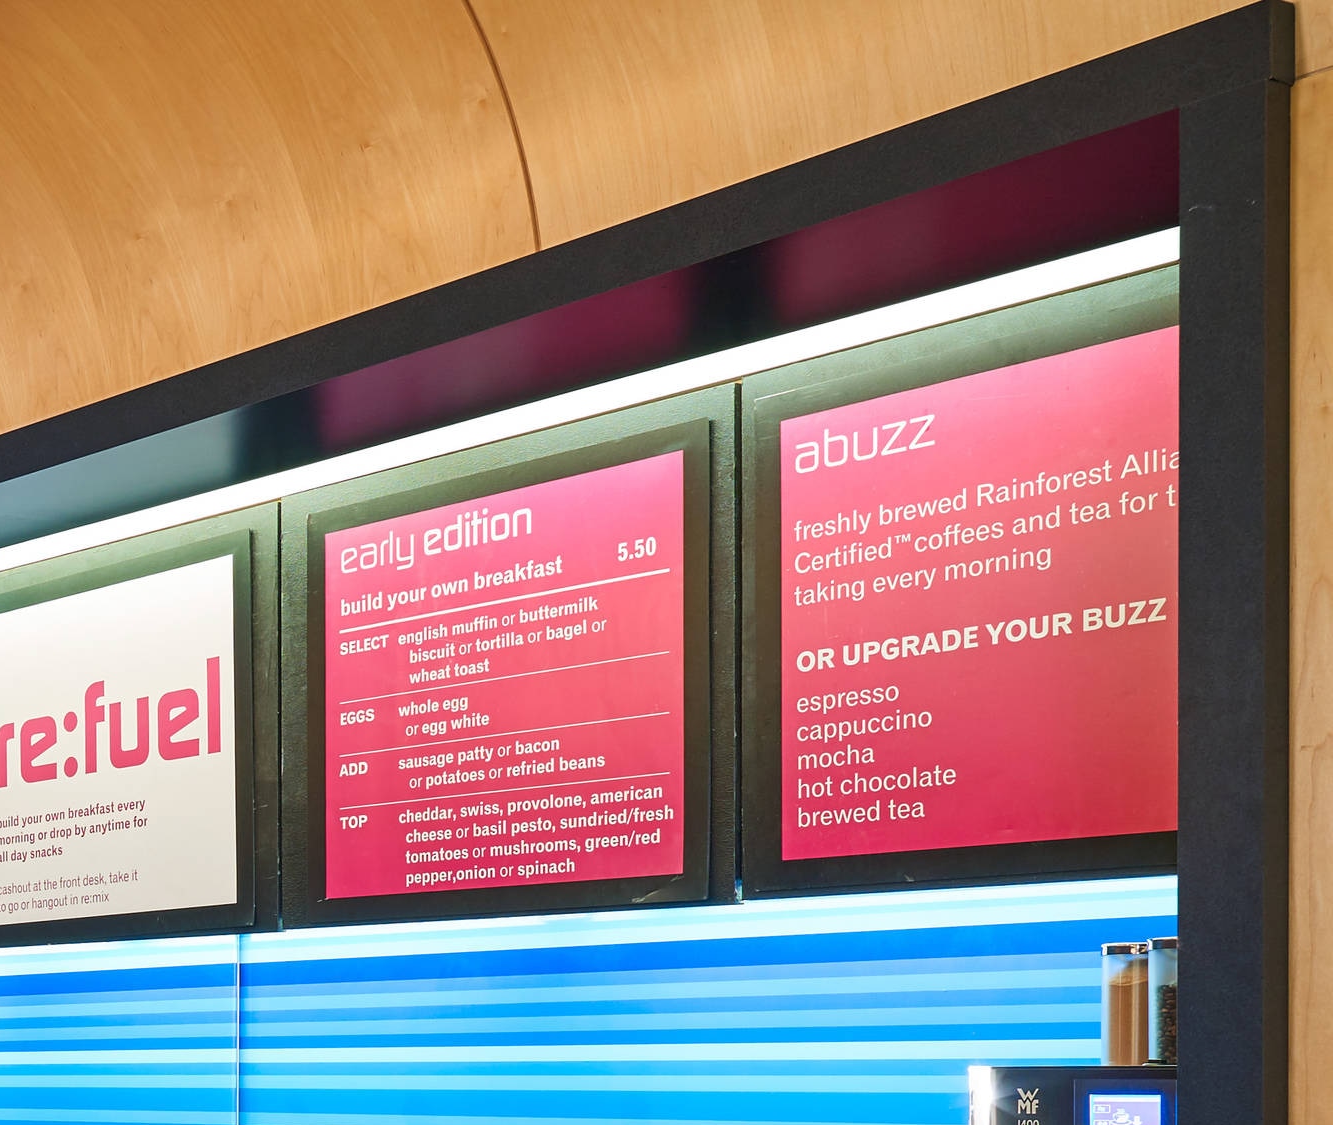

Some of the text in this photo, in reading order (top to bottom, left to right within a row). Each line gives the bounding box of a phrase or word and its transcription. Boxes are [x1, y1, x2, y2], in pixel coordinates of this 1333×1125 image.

[794, 413, 935, 474] abuzz
[793, 509, 871, 541] freshly
[878, 487, 966, 525] brewed
[976, 459, 1112, 507] Rainforest
[914, 521, 1004, 552] coffees
[1012, 504, 1060, 535] and
[1068, 501, 1111, 524] tea
[1118, 491, 1158, 515] for
[340, 507, 532, 574] early edition
[340, 536, 656, 616] build your own breakfast 5.50
[793, 547, 1051, 606] taking every morning
[339, 595, 598, 655] SELECT english muffin or buttermilk
[409, 619, 607, 663] biscuit or tortilla or bagel or
[796, 597, 1166, 672] OR UPGRADE YOUR BUZZ
[408, 657, 489, 684] wheat toast
[340, 696, 468, 725] EGGS whole egg
[796, 685, 899, 714] espresso
[405, 712, 490, 736] or egg white
[796, 709, 932, 743] cappuccino
[339, 738, 559, 777] ADD sausage patty or bacon
[408, 755, 605, 790] or potatoes or refried beans
[797, 743, 875, 770] mocha
[797, 764, 956, 799] hot chocolate
[21, 814, 42, 828] your
[44, 811, 65, 822] own
[67, 801, 114, 819] breakfast
[116, 799, 145, 812] every
[339, 785, 662, 829] TOP cheddar, swiss, provolone, american
[405, 804, 674, 843] cheese or basil pesto, sundried/fresh
[797, 798, 925, 827] brewed tea
[37, 831, 47, 840] or
[49, 826, 72, 839] drop
[74, 823, 86, 837] by
[88, 818, 131, 834] anytime
[132, 815, 147, 828] for
[404, 827, 660, 864] tomatoes or mushrooms, green/red
[10, 849, 27, 863] day
[29, 844, 63, 859] snacks
[405, 857, 575, 887] pepper,onion or spinach
